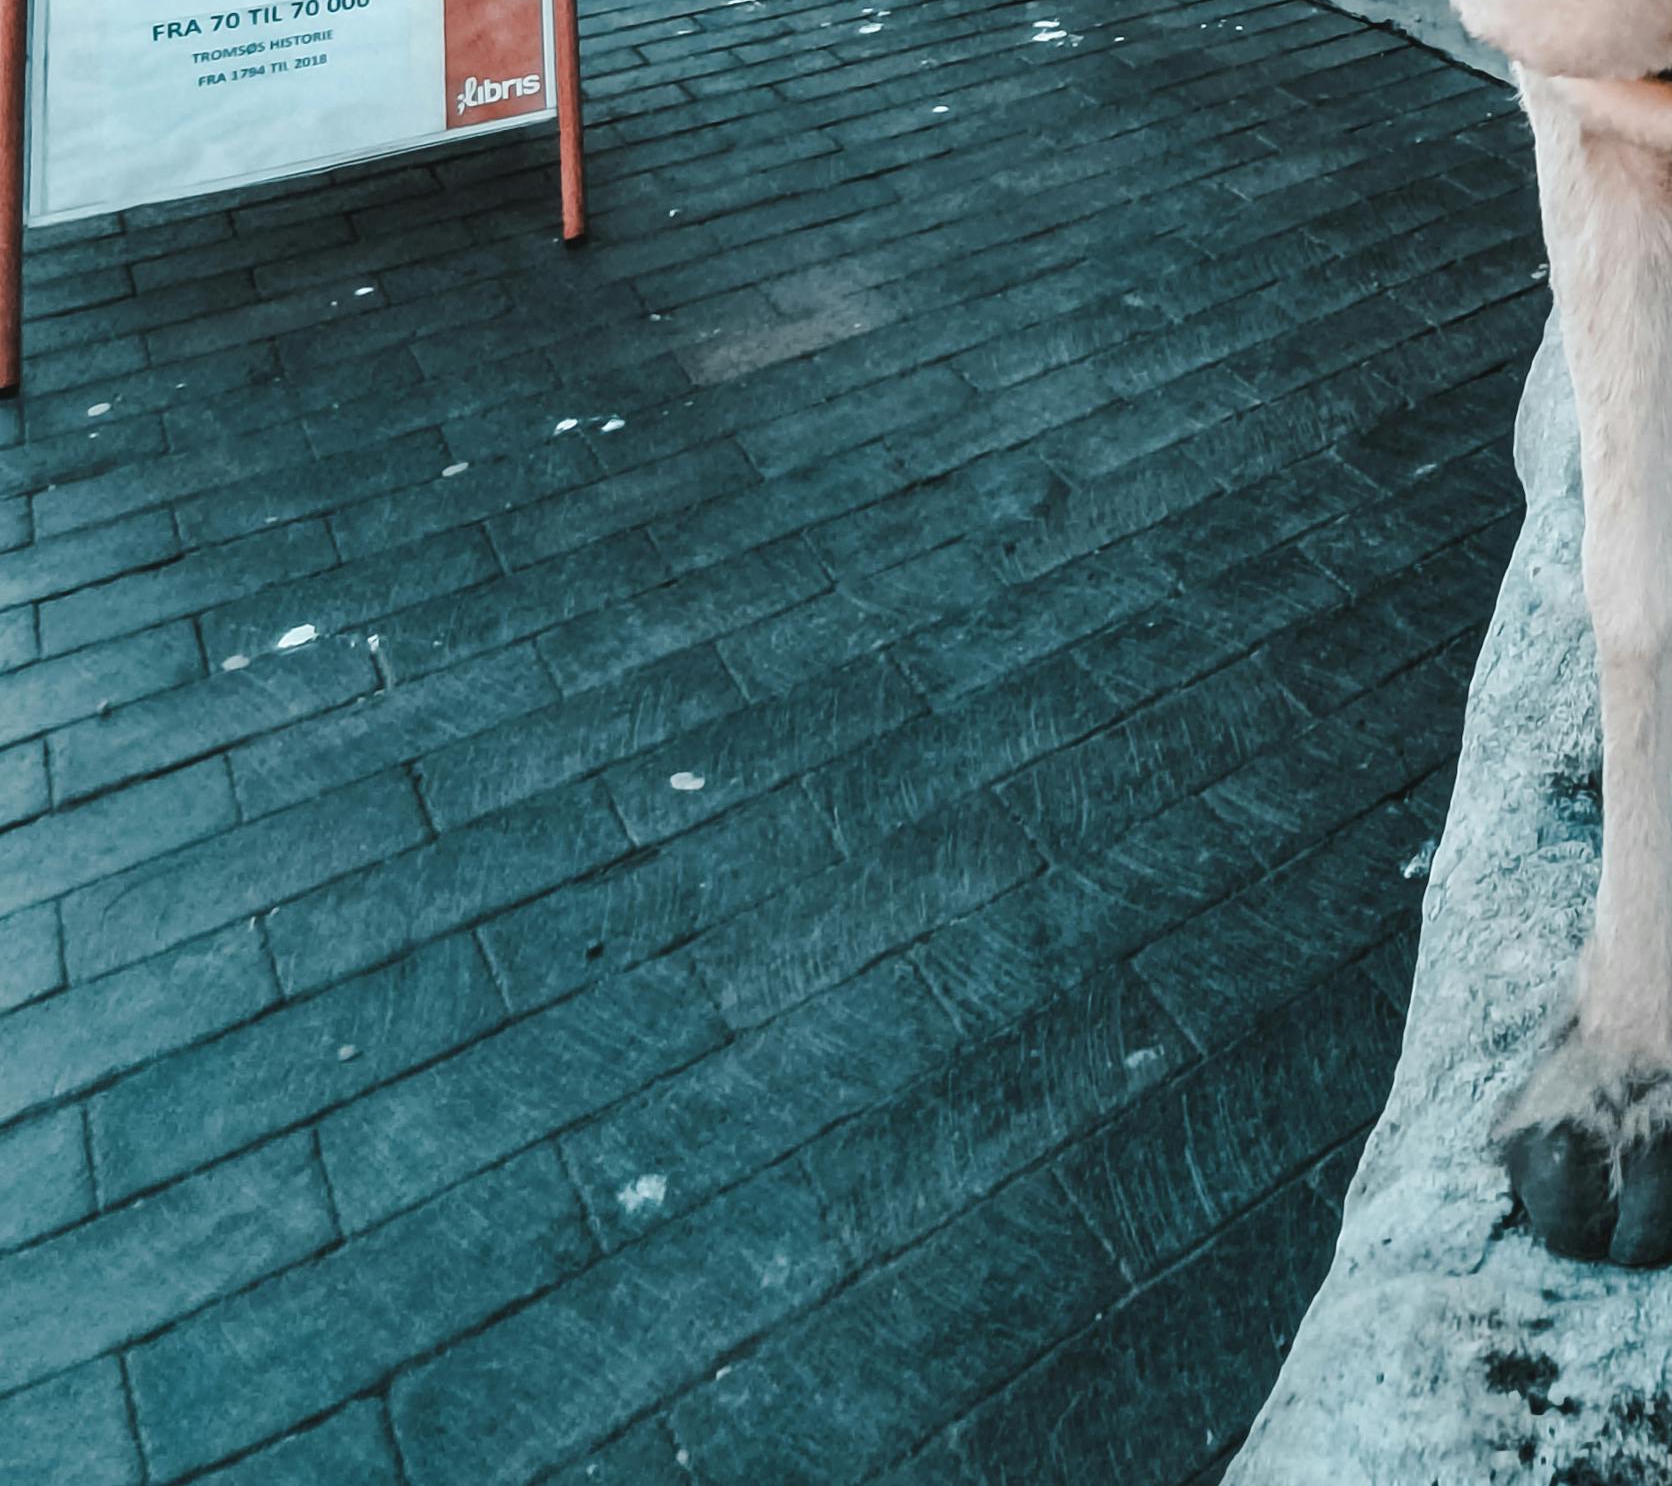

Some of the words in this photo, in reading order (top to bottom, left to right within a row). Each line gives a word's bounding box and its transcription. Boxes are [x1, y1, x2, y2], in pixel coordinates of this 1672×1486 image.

[152, 18, 202, 42] FRA
[210, 11, 240, 32] 70
[248, 5, 283, 26] TIL
[192, 41, 266, 65] TROMSØS
[269, 29, 334, 51] HISTORIE
[197, 72, 227, 89] FRA
[270, 61, 289, 75] TIL
[294, 53, 328, 69] 2018
